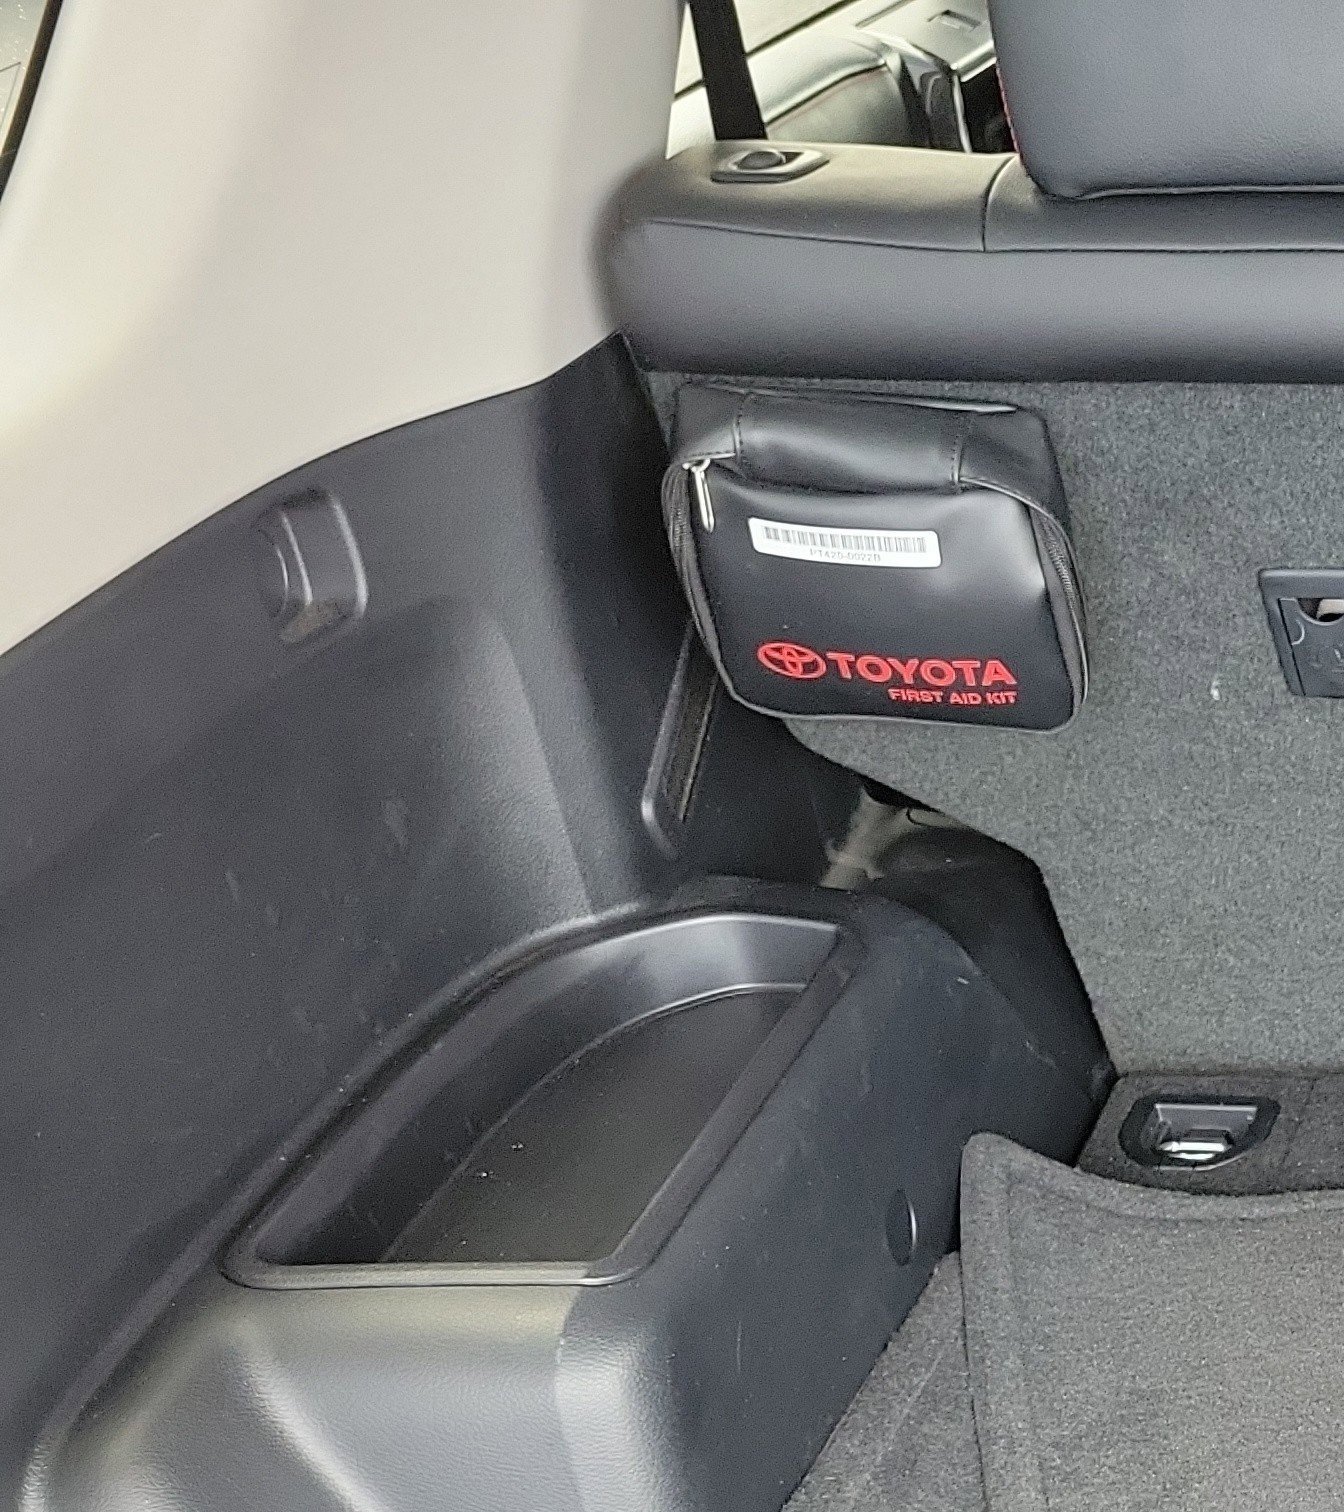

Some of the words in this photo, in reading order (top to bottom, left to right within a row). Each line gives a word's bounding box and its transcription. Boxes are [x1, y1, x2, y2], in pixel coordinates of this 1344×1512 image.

[826, 652, 1017, 687] TOYOTA
[888, 688, 943, 704] FIRST
[949, 690, 981, 705] AID
[986, 690, 1017, 704] KIT
